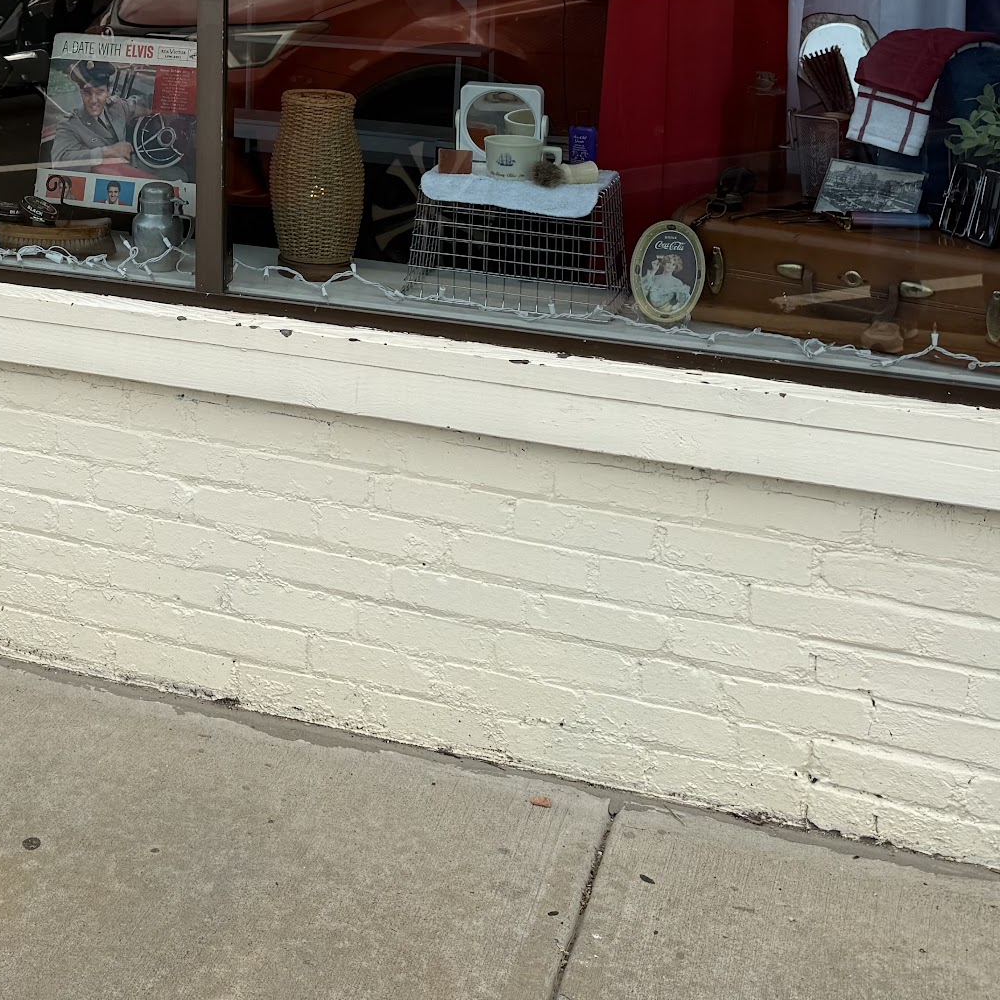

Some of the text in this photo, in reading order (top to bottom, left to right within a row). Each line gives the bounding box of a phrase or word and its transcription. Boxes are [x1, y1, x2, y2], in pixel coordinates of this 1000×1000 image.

[62, 41, 154, 59] A DATE WITH ELVIS
